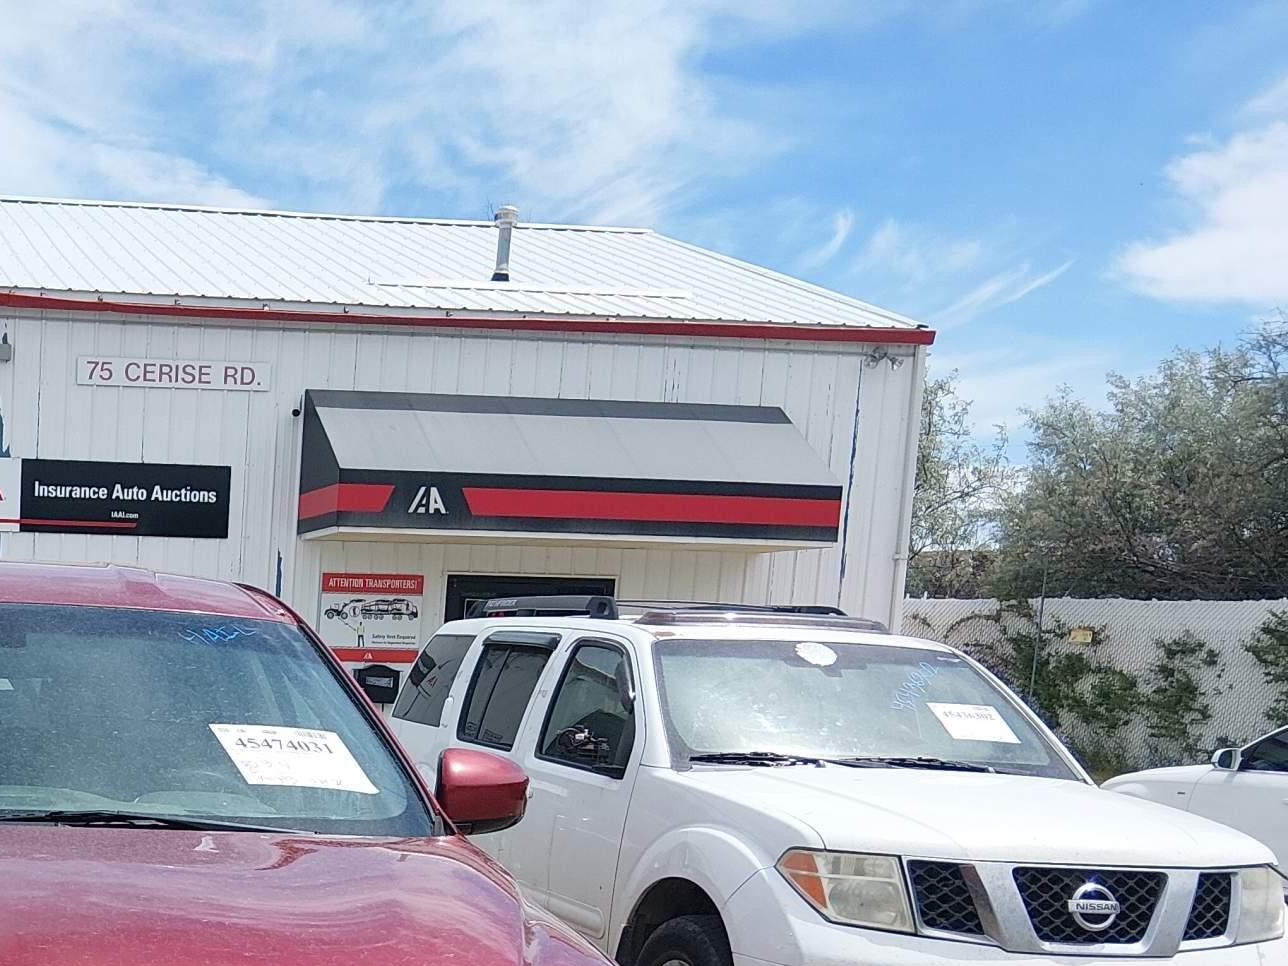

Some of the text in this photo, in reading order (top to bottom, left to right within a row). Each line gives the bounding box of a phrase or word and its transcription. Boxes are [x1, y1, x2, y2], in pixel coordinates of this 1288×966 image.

[86, 361, 261, 386] 75 CERISE RD.
[34, 481, 217, 504] Insurance Auto Auctions
[328, 577, 418, 589] ATTENTION TRANSPORTERS!
[234, 737, 334, 755] 45474031
[1075, 903, 1117, 911] NISSAN
